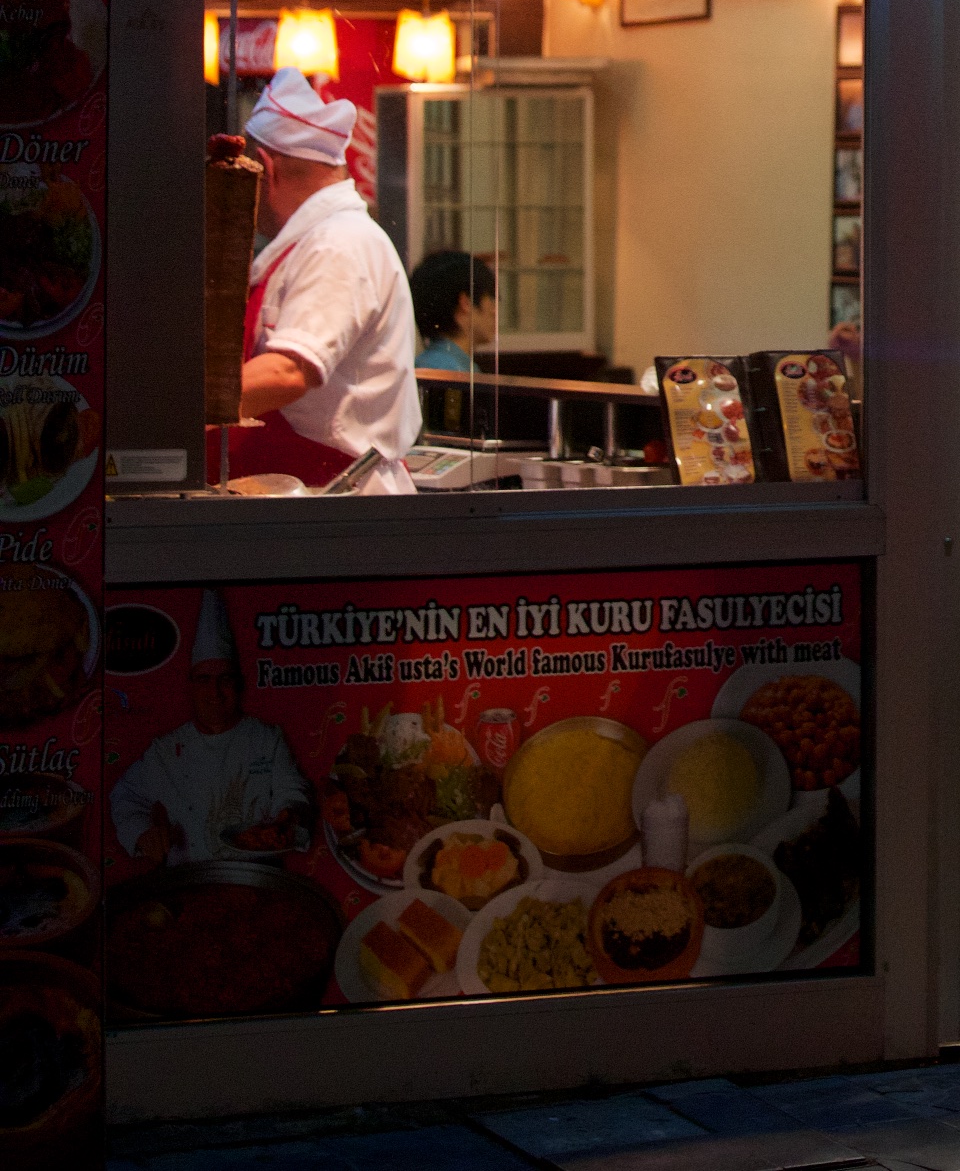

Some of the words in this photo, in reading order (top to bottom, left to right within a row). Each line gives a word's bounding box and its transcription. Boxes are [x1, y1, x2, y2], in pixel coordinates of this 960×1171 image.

[0, 132, 90, 164] Döner
[0, 345, 90, 376] Dürüm
[467, 605, 510, 639] EN
[516, 597, 561, 637] İYİ
[566, 600, 653, 636] KURU
[659, 585, 843, 632] FASULYECİSİ
[257, 659, 340, 688] Famous
[345, 653, 394, 685] Akif
[400, 651, 459, 682] usta's
[463, 648, 526, 679] World
[532, 646, 606, 677] famous
[609, 640, 736, 674] Kurufasulye
[740, 637, 788, 666] with
[793, 636, 842, 663] meat
